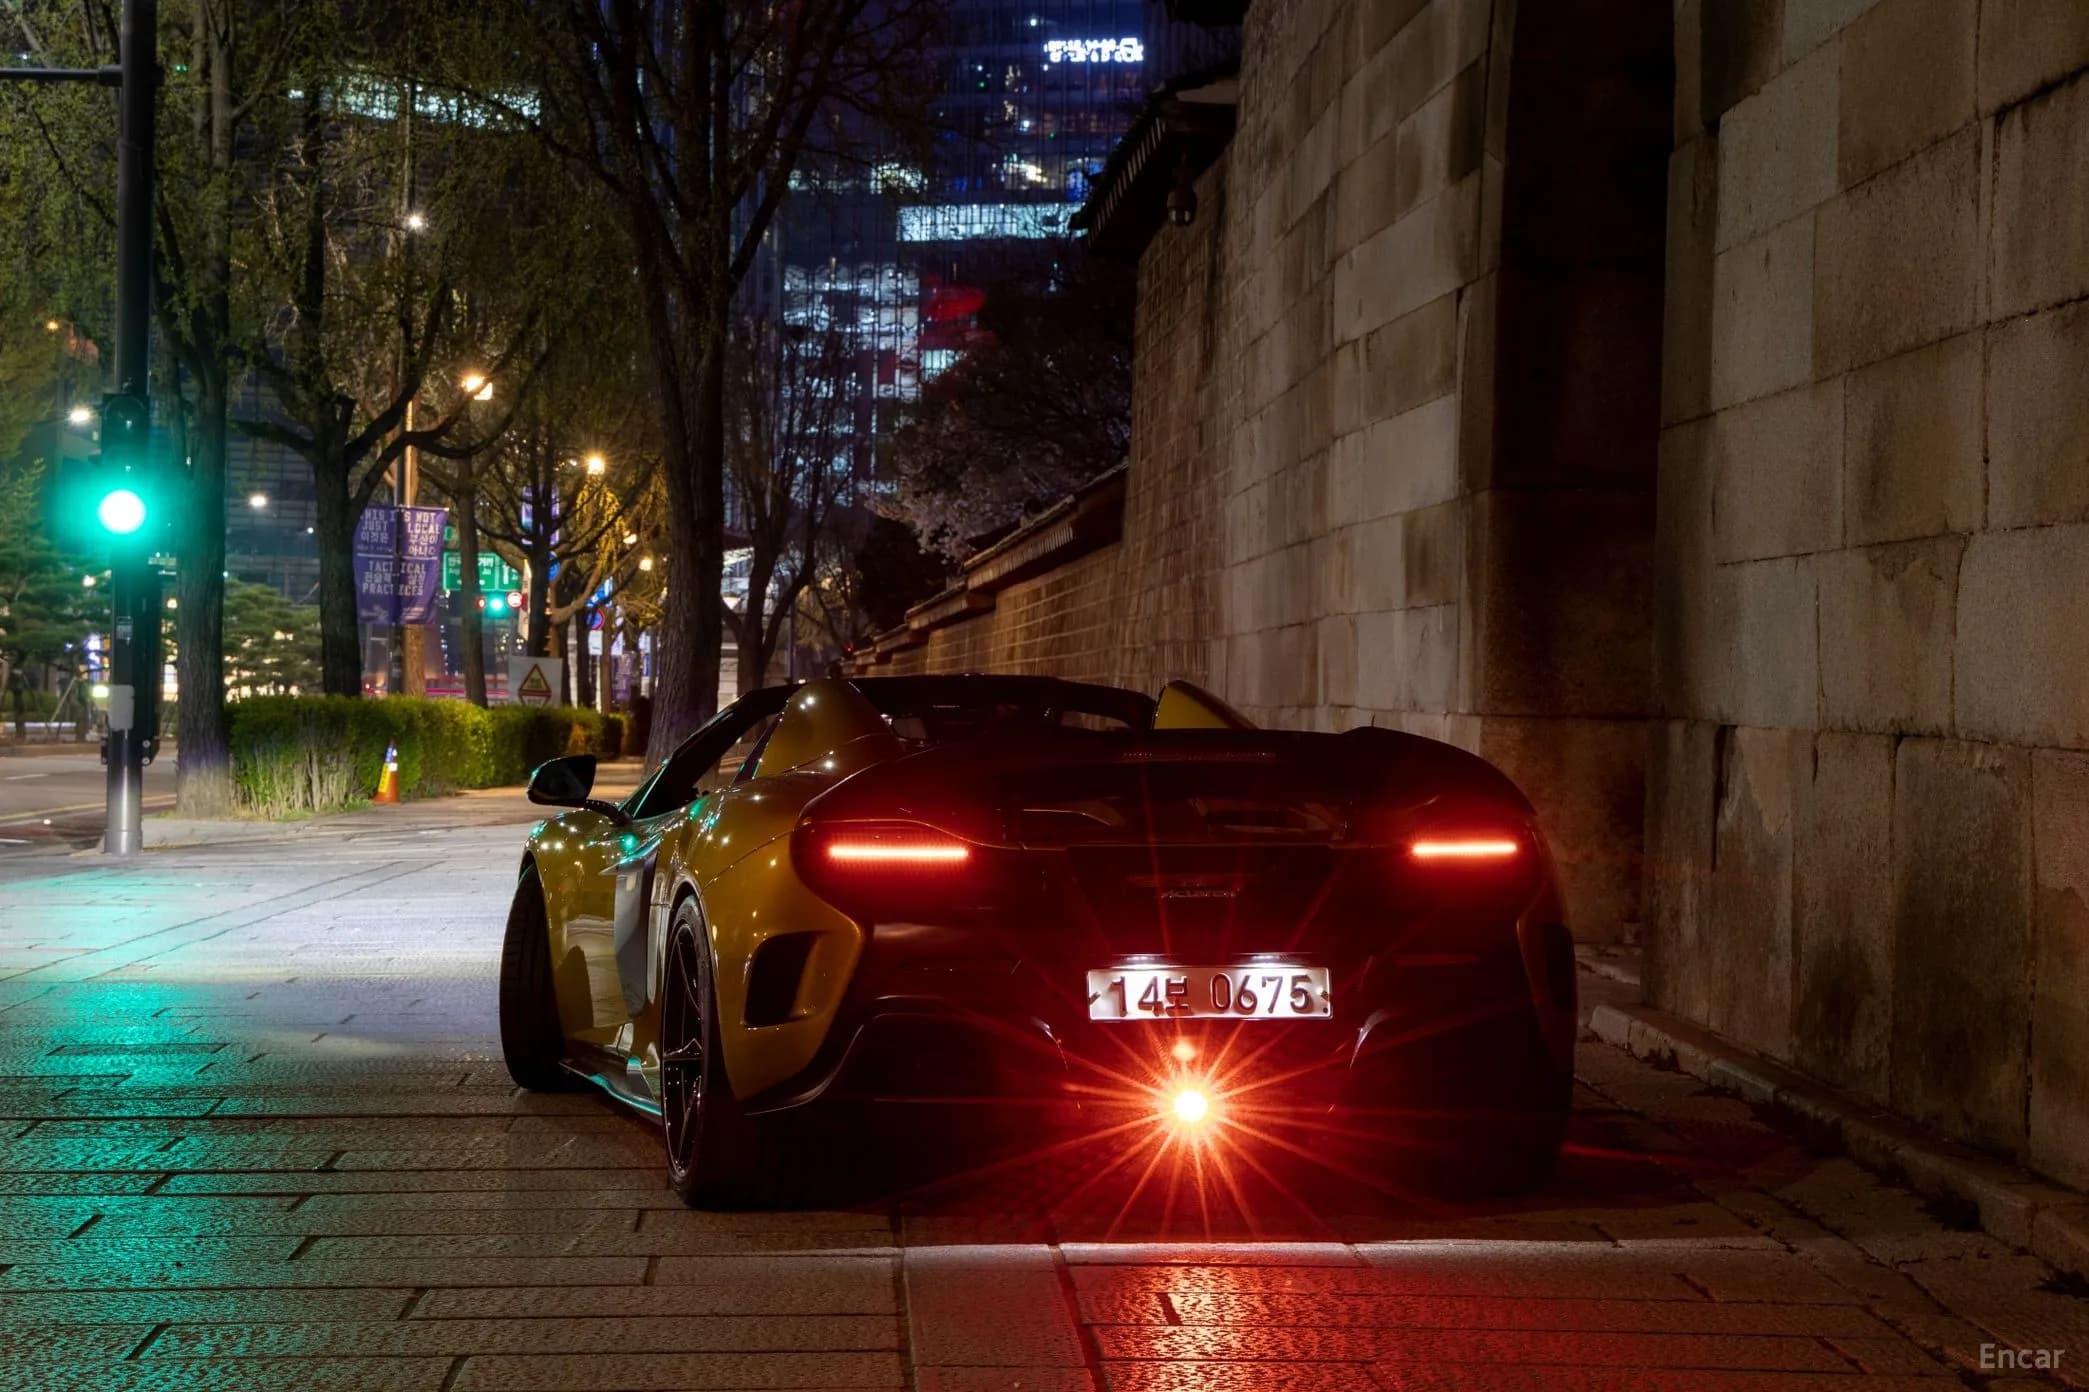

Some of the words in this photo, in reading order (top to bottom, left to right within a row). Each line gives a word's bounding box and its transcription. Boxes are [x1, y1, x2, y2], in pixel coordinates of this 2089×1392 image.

[415, 511, 437, 524] NOT
[362, 519, 388, 532] JUST
[408, 522, 440, 535] LOCAL
[1108, 975, 1193, 1017] 14보
[1210, 973, 1314, 1015] 0675
